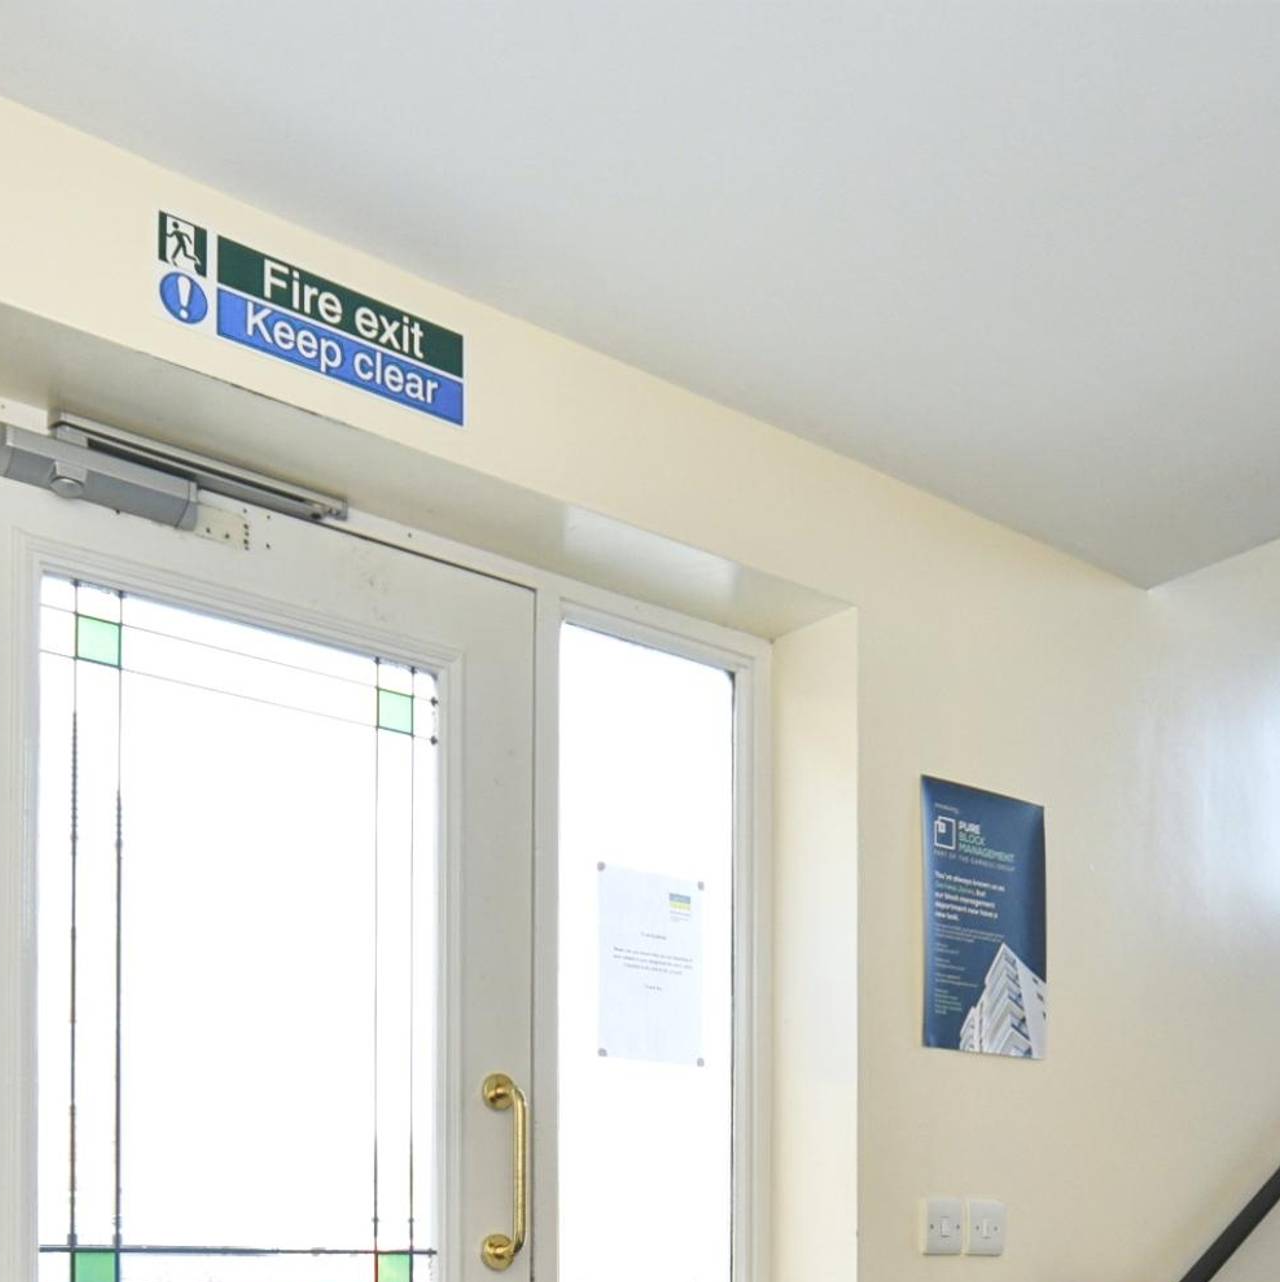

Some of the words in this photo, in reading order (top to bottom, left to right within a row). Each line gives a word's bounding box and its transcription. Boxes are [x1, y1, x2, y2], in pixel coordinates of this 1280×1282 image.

[263, 258, 343, 325] Fire
[354, 306, 425, 358] exit
[245, 300, 343, 373] Keep
[353, 350, 438, 404] clear
[959, 821, 980, 835] PURE
[959, 831, 986, 846] BLOCK
[959, 842, 1015, 863] MANAGEMENT
